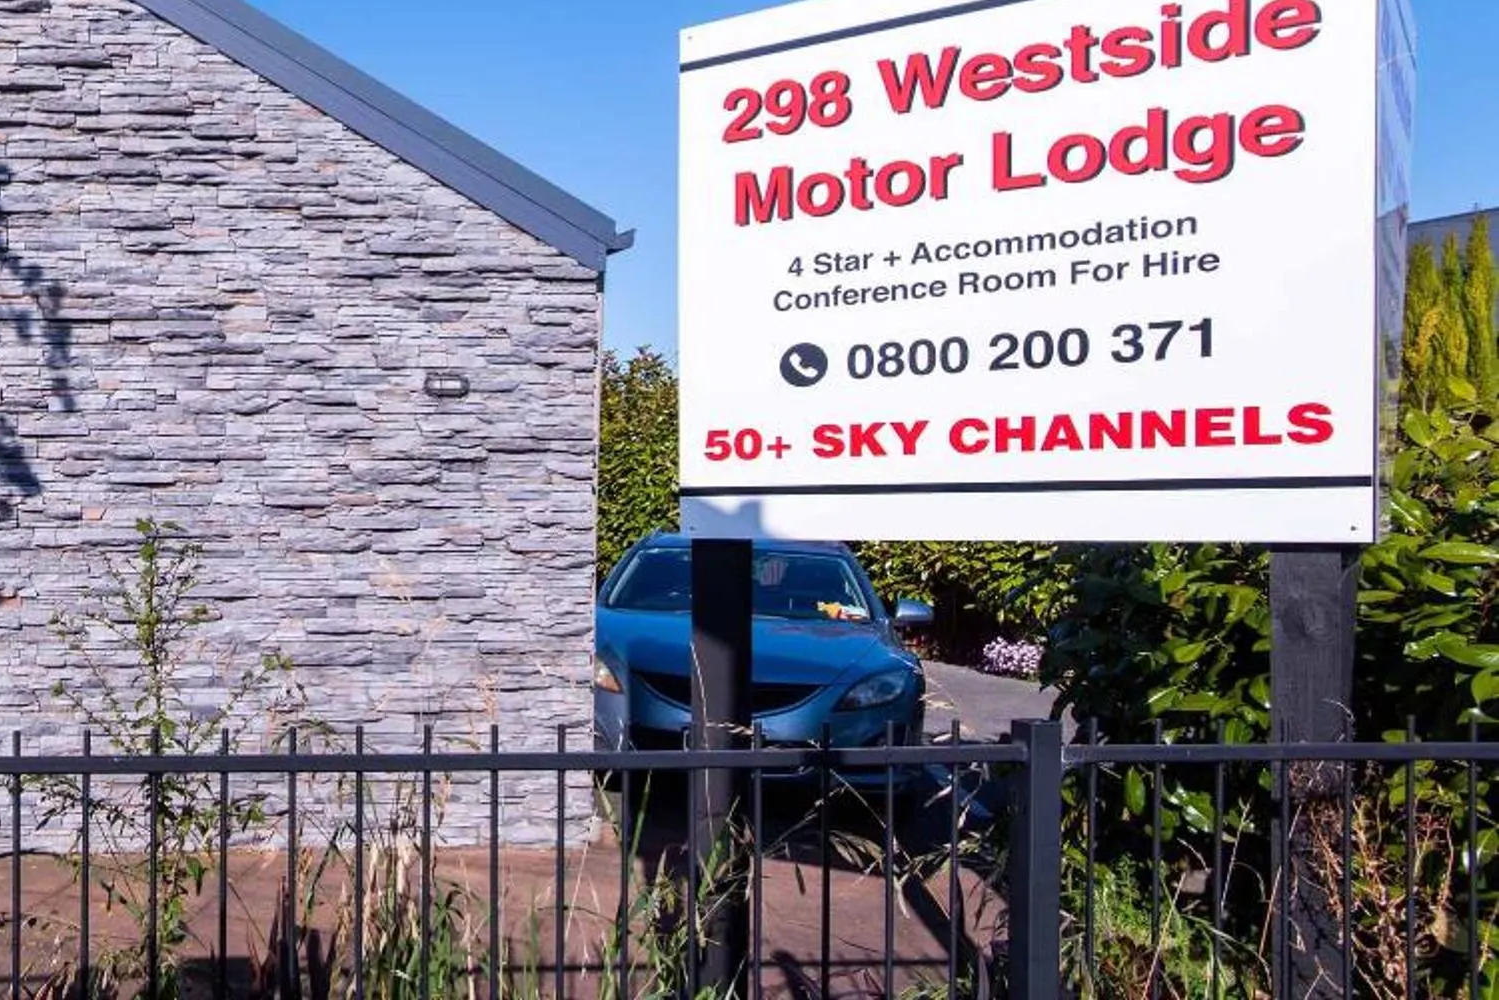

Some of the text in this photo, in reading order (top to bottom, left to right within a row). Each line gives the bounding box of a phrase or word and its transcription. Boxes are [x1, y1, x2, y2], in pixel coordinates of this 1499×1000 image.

[722, 71, 852, 144] 298
[735, 105, 1305, 227] Motor Lodge
[788, 217, 1196, 276] 4 Star + Accommodation
[774, 251, 1220, 311] Conference Room For Hire
[848, 318, 1211, 379] 0800 200 371
[704, 402, 1333, 461] 50+ SKY CHANNELS
